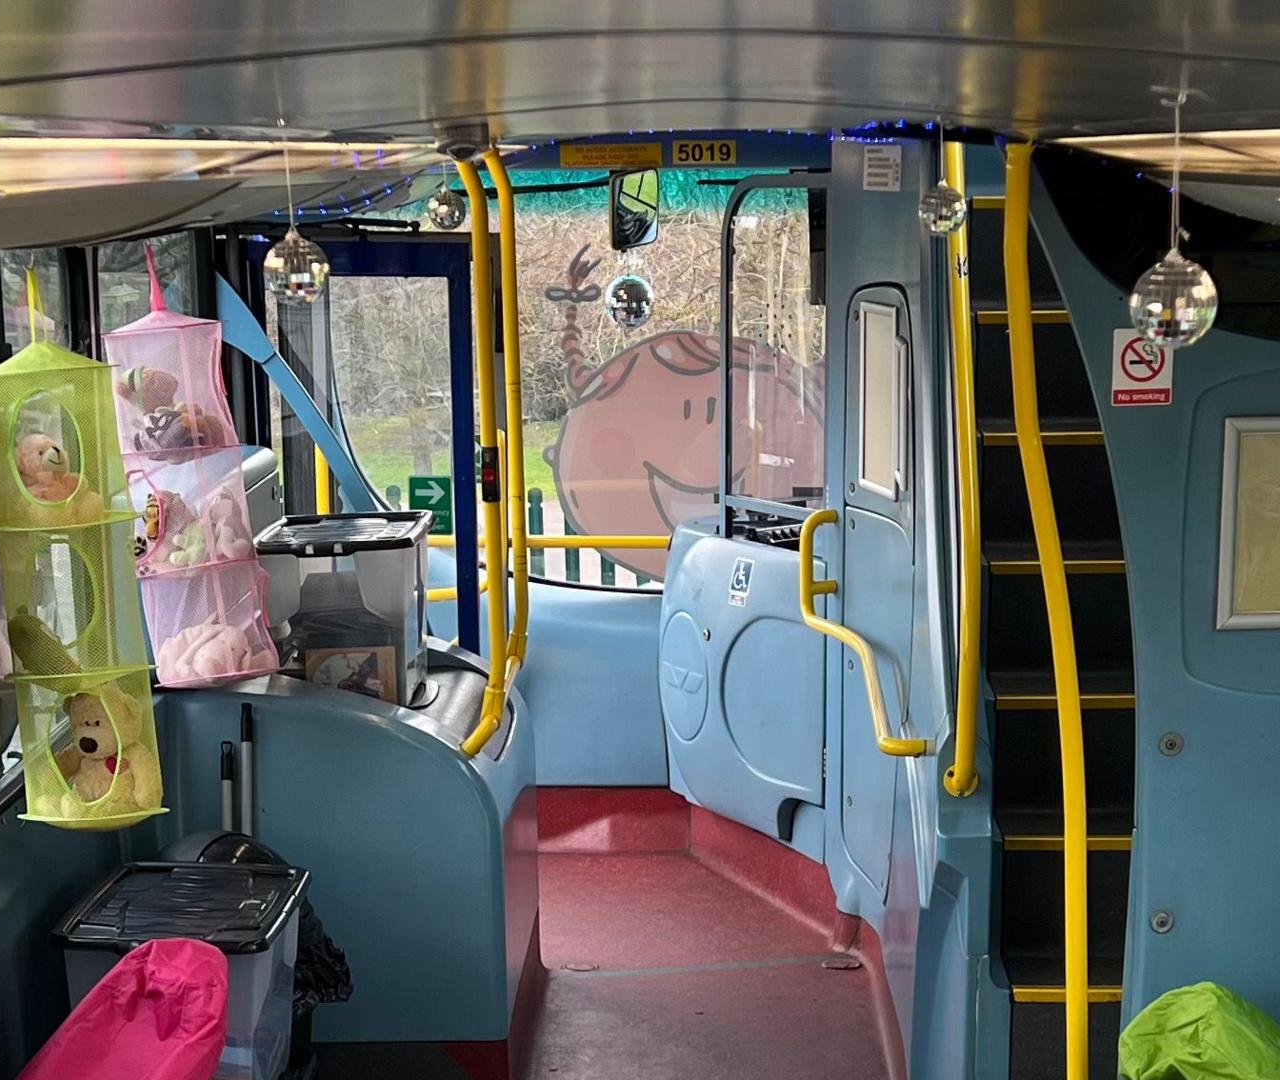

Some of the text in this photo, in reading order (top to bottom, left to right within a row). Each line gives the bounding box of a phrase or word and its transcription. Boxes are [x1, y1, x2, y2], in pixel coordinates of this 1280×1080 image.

[678, 143, 731, 162] 5019
[1117, 392, 1166, 401] No smoking
